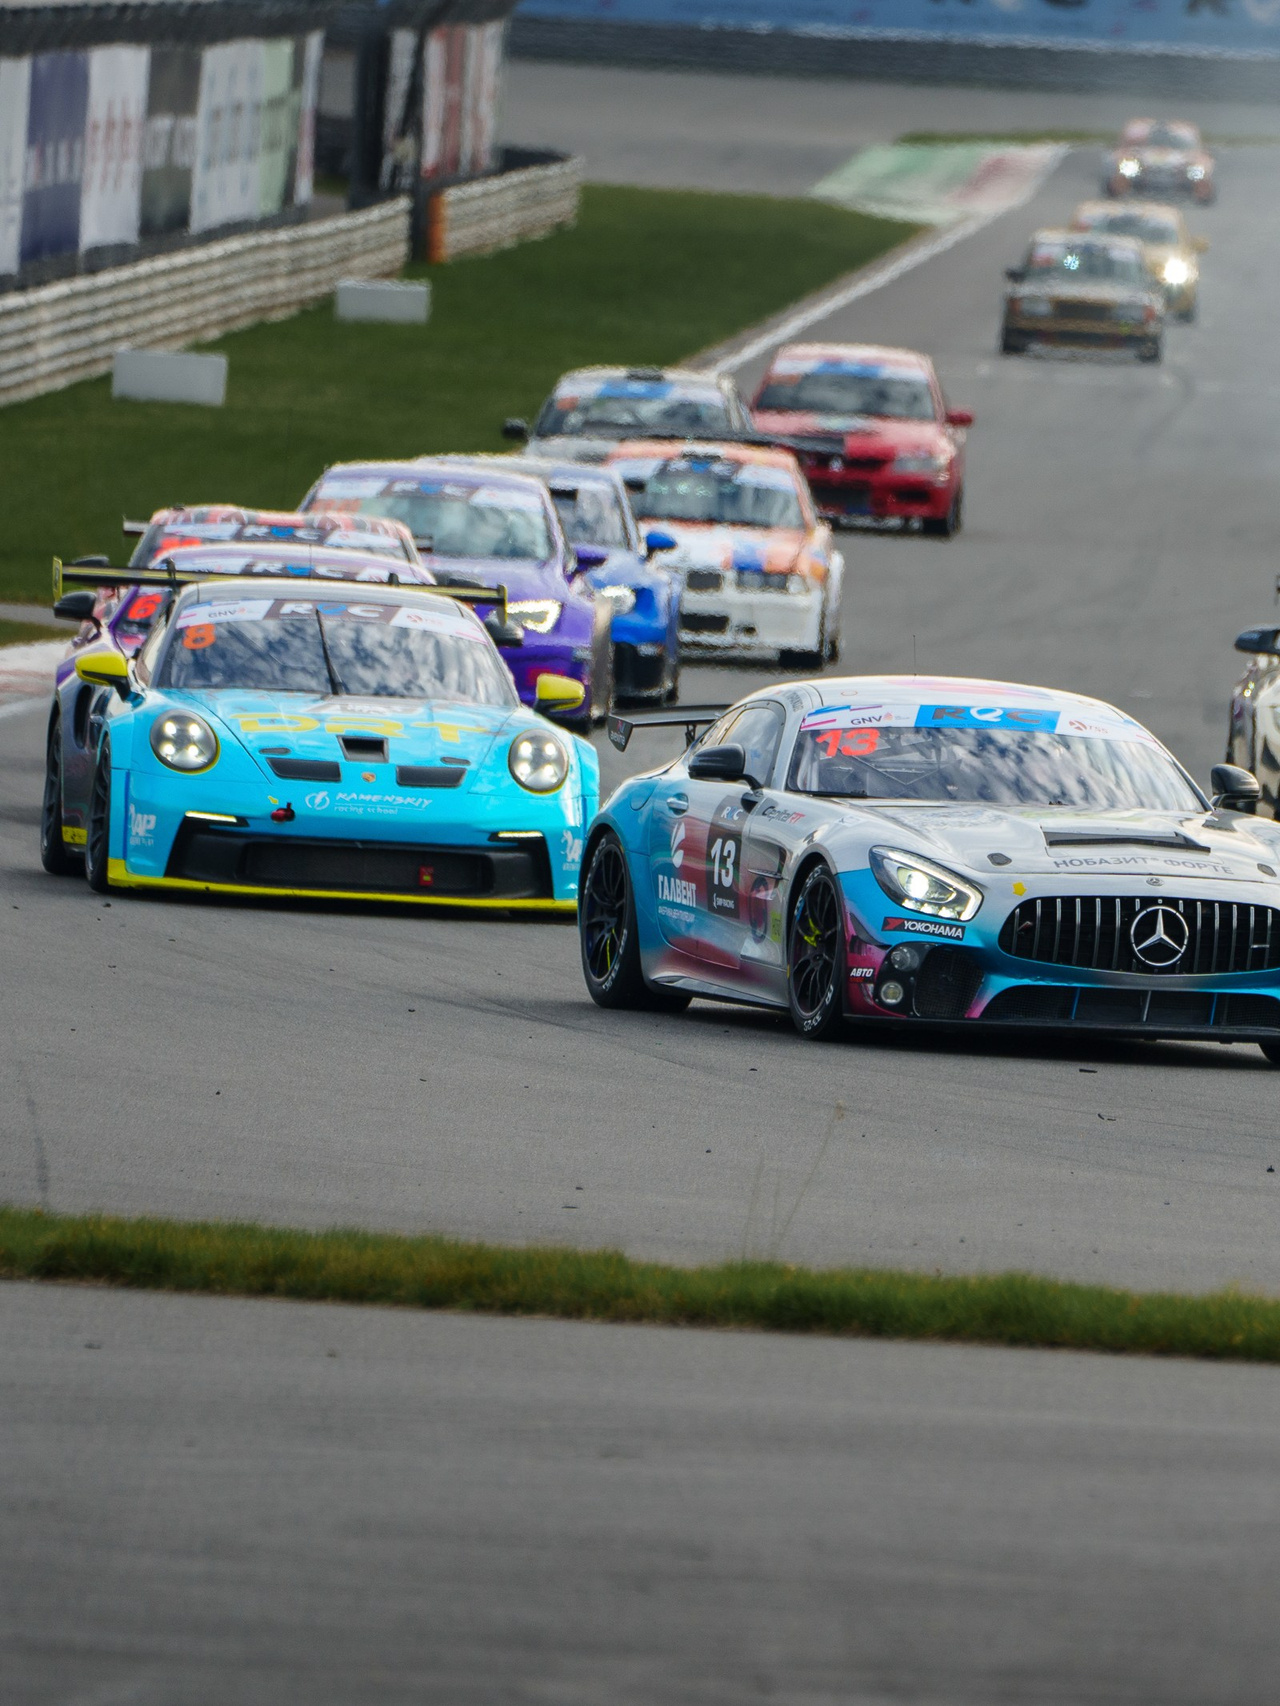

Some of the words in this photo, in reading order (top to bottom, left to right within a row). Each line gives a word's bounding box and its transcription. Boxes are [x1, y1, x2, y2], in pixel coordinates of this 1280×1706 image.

[127, 593, 162, 620] 6
[182, 623, 217, 650] 8
[229, 712, 487, 744] DRT
[851, 714, 883, 727] GNV
[815, 728, 881, 758] 13
[710, 838, 736, 887] 13
[1164, 859, 1235, 875] ФОРТЕ
[658, 875, 697, 908] ГАЛВЕНТ
[903, 920, 963, 939] YOKOHAMA
